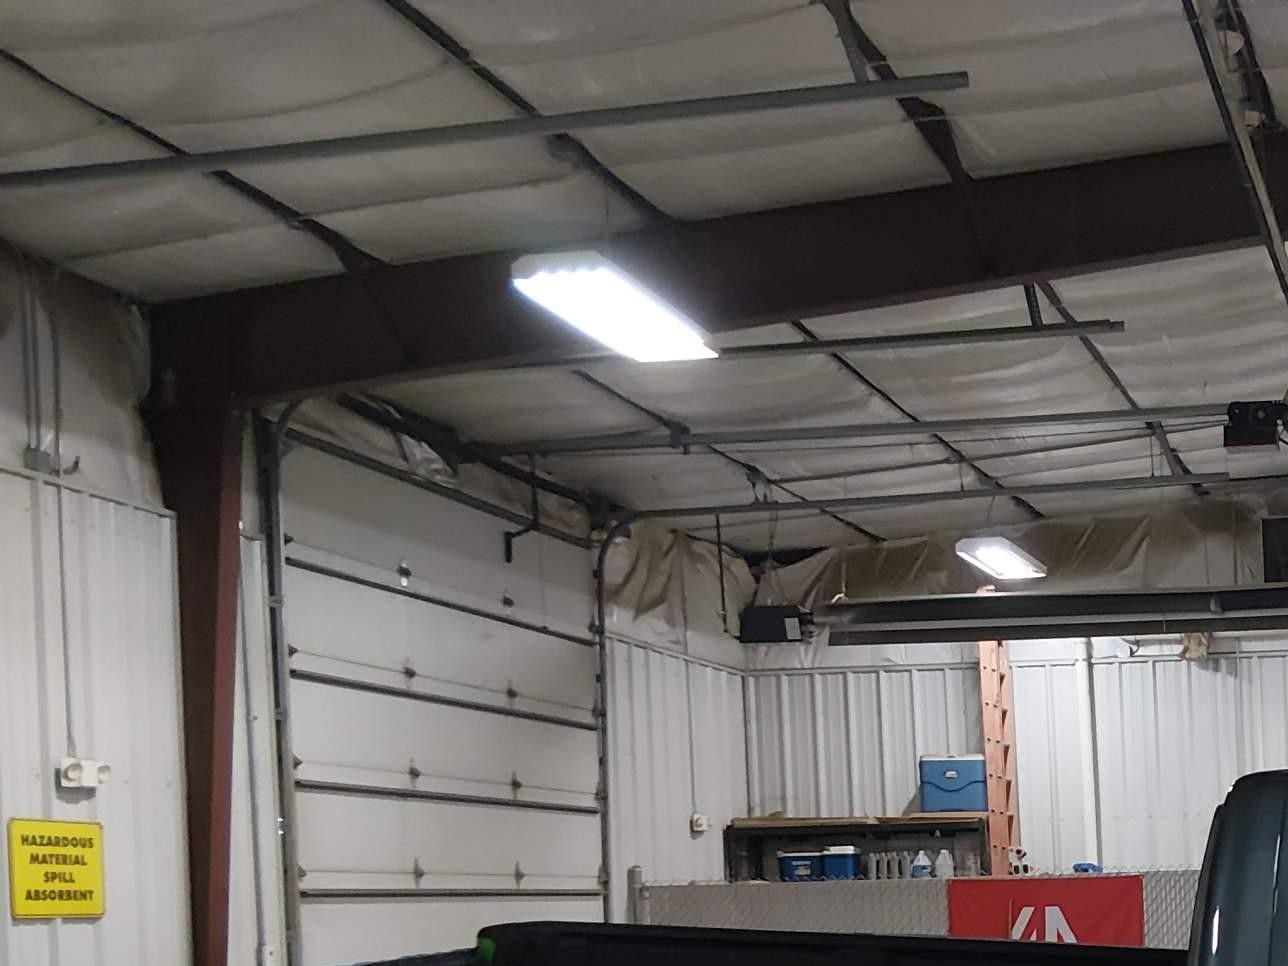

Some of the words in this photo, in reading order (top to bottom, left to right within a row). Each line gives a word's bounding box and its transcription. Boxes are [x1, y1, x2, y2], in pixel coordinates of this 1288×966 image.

[20, 834, 94, 848] HAZARDOUS
[29, 853, 88, 866] MATERIAL
[43, 871, 76, 883] SPILL
[25, 889, 94, 901] ABSORBENT
